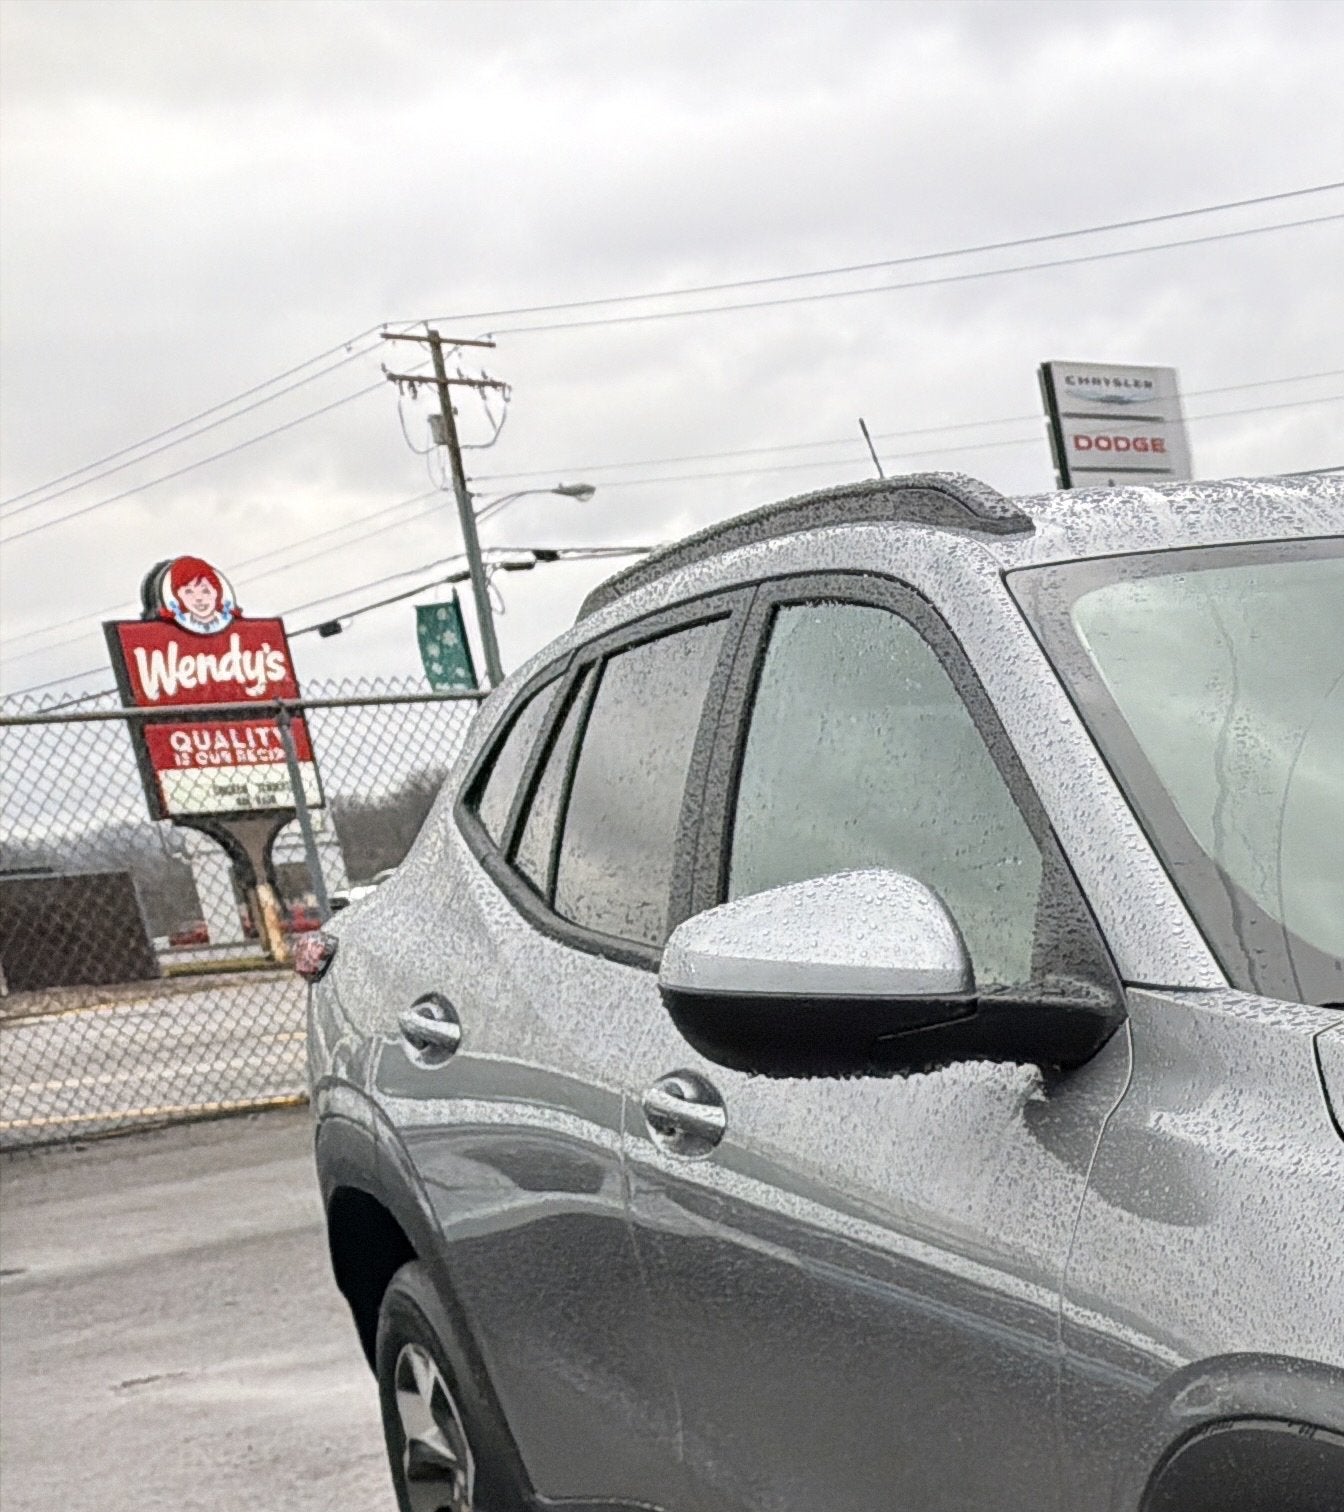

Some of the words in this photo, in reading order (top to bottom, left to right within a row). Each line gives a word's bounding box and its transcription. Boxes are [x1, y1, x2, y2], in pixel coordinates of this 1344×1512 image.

[1064, 375, 1153, 389] CHRYSLER
[1073, 434, 1167, 454] DODGE
[132, 632, 287, 701] Wendy's
